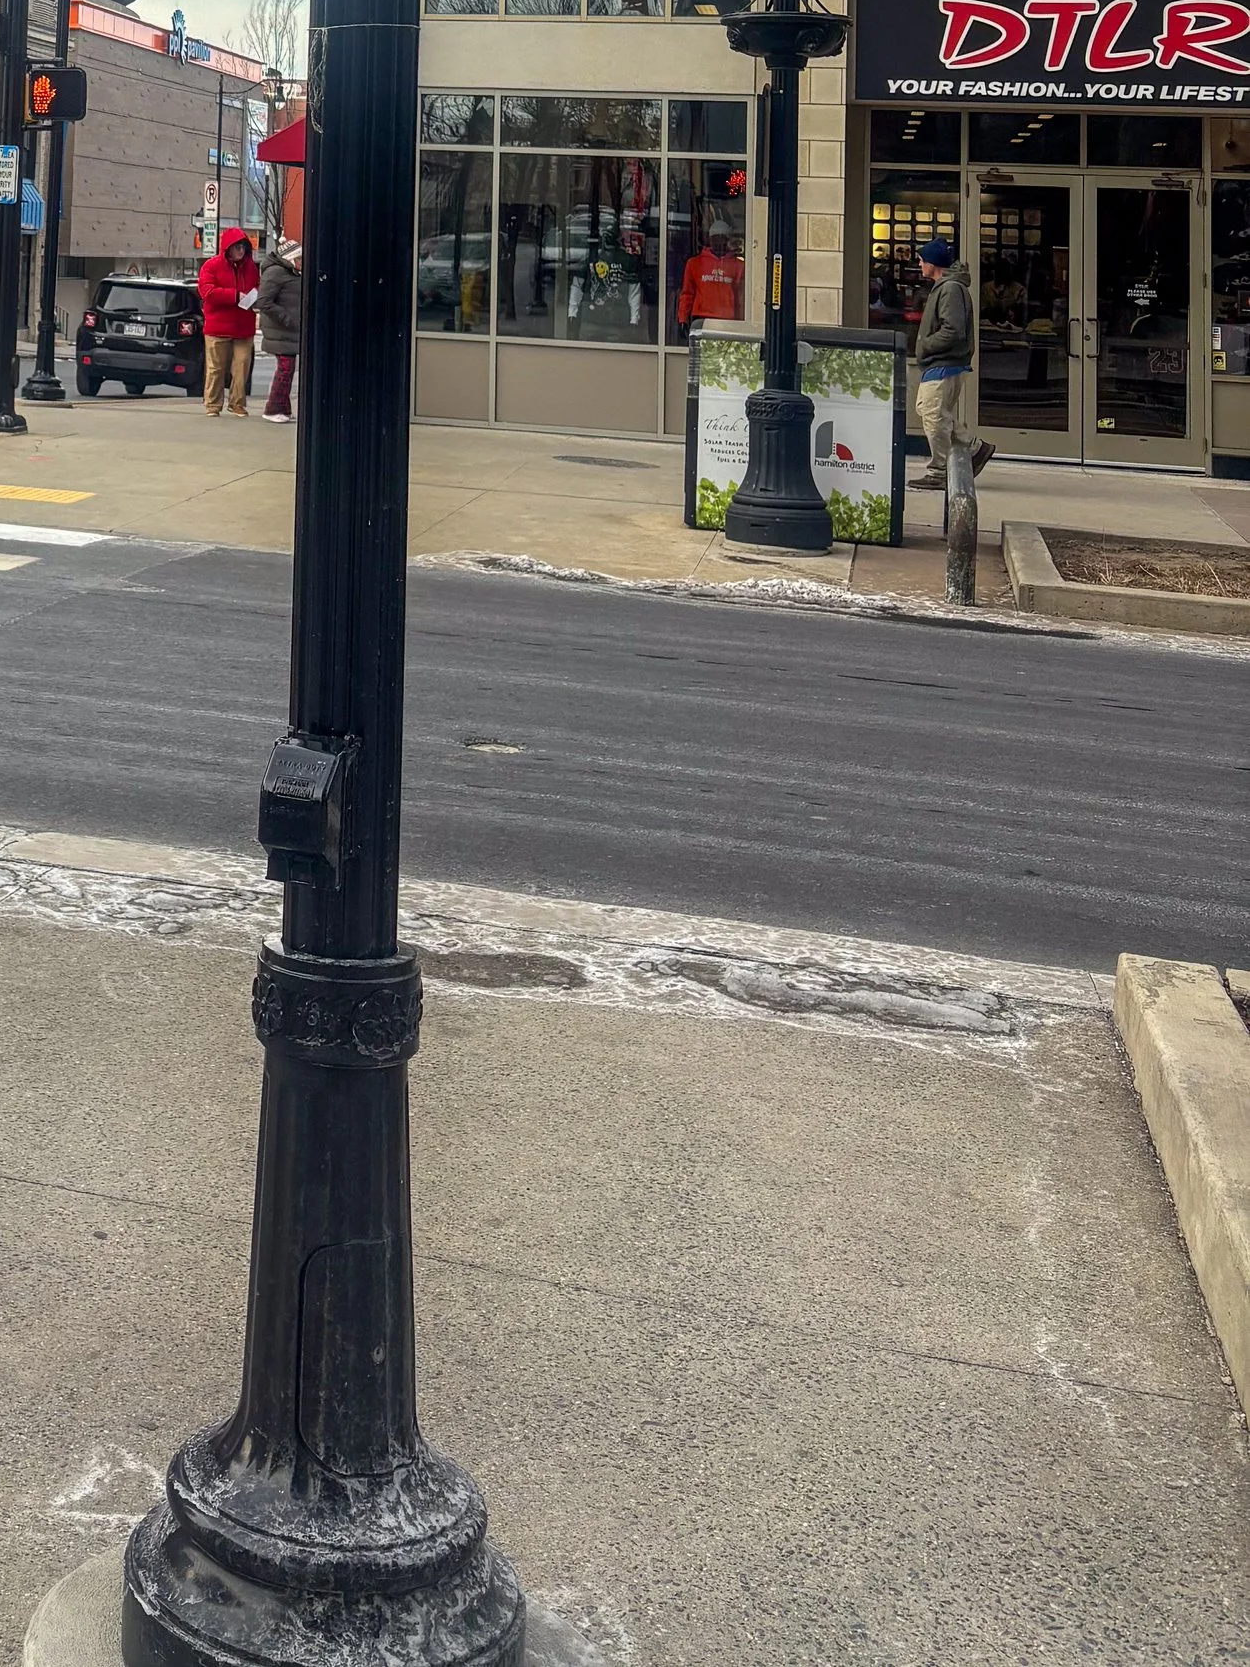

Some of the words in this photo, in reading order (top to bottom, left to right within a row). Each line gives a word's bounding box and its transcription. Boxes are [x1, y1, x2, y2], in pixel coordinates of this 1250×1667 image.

[887, 79, 954, 95] YOUR
[704, 414, 743, 431] Think
[814, 459, 848, 468] hamilton
[849, 461, 875, 470] district
